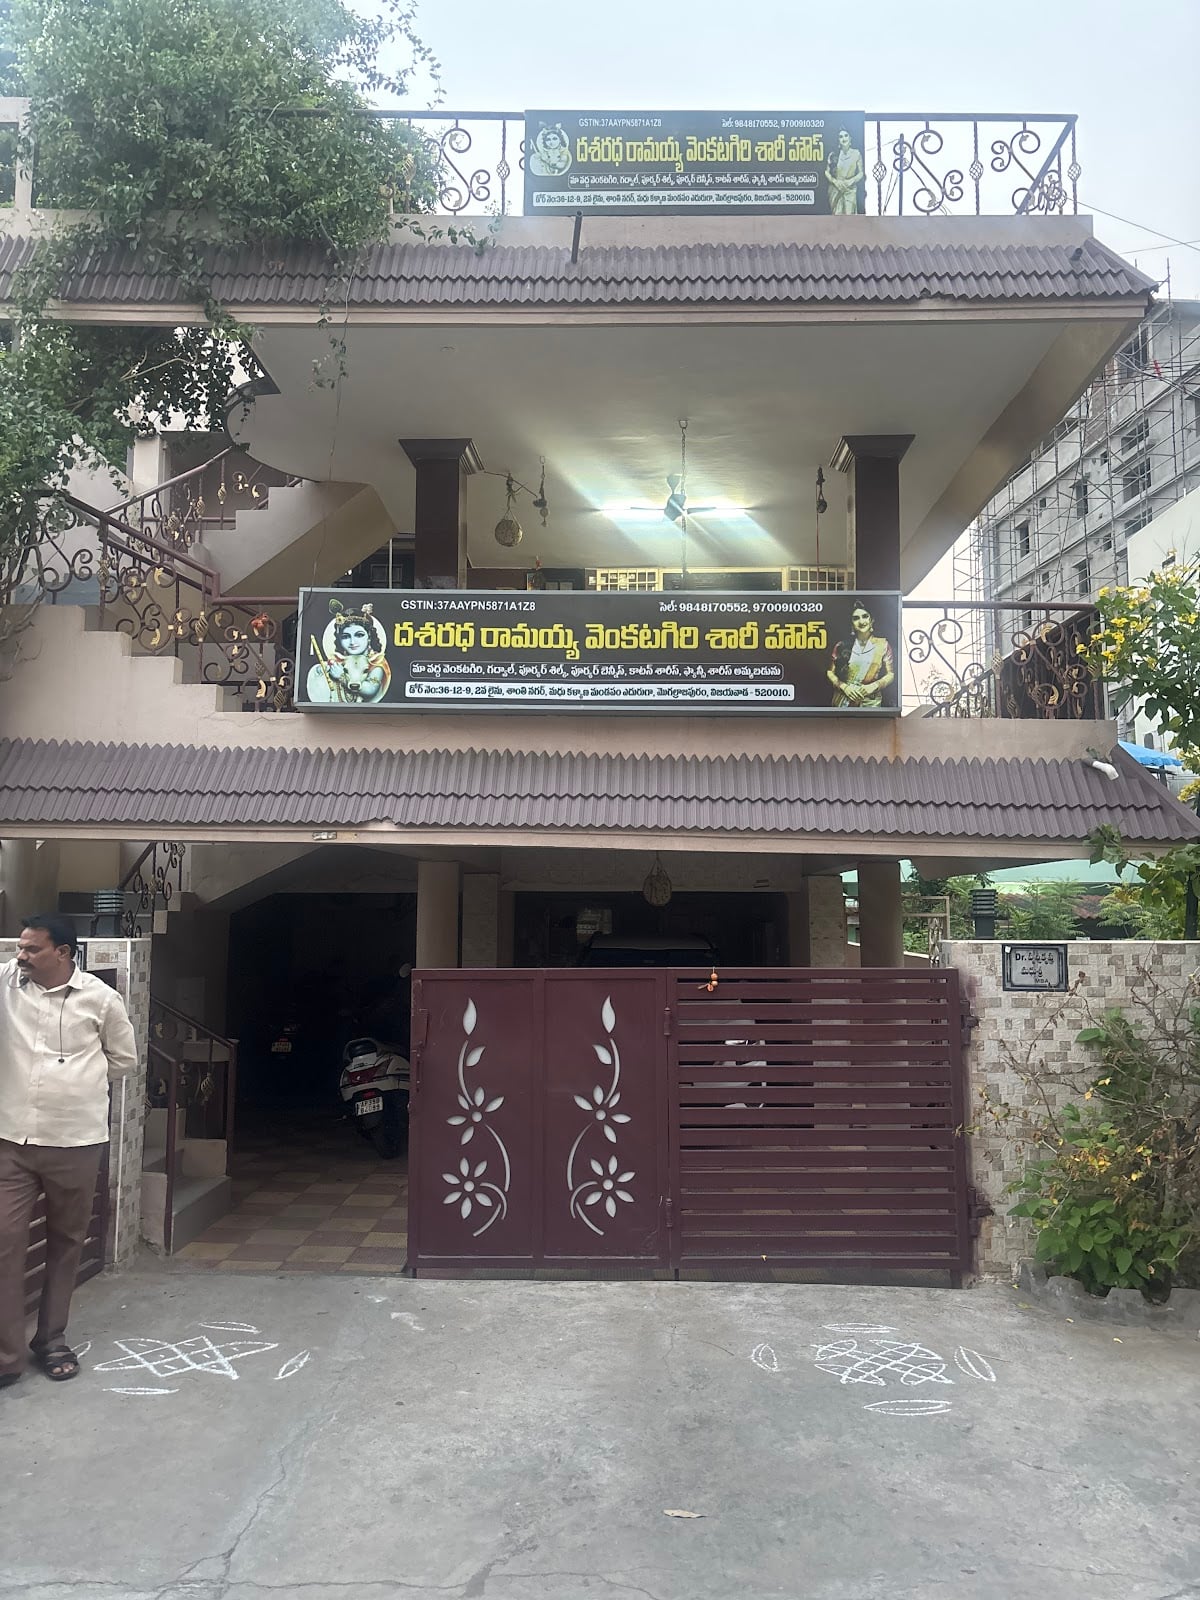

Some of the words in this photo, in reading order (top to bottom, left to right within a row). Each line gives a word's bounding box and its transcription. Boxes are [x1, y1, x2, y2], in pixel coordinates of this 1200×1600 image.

[734, 119, 780, 129] 9848170552,
[780, 119, 825, 128] 9700910320
[626, 136, 684, 173] రామయ్య
[686, 134, 752, 162] వెంకటగిరి
[754, 134, 786, 162] శారీ
[788, 133, 824, 162] హౌస్
[400, 600, 536, 611] GSTIN:37AAYPN5871A1Z8
[679, 602, 751, 613] 9848170552,
[752, 602, 823, 612] 9700910320
[393, 621, 475, 652] దశరధ
[480, 623, 580, 660] రామయ్య
[585, 621, 699, 649] వెంకటగిరి
[704, 621, 759, 649] శారీ
[764, 621, 827, 649] హౌస్
[754, 688, 791, 697] 520010.
